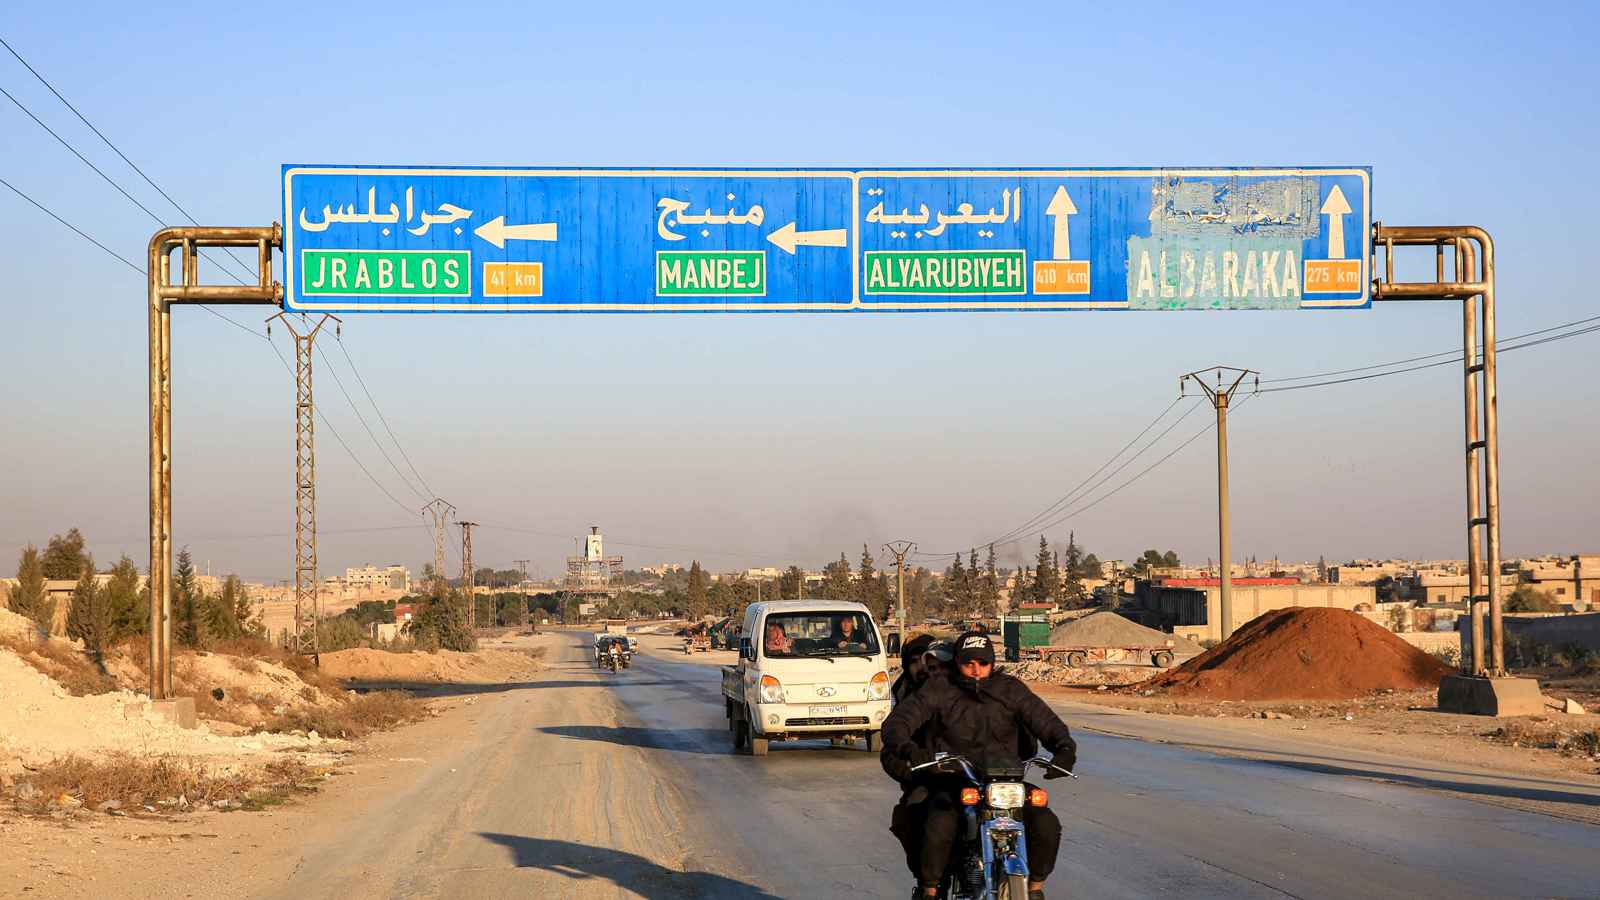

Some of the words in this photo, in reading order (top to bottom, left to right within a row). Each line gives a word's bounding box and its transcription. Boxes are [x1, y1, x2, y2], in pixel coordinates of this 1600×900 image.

[299, 185, 473, 236] جرابلس
[657, 192, 765, 241] منبج
[865, 187, 1021, 239] اليعربية
[311, 256, 460, 289] JRABLOS
[490, 270, 505, 286] 41
[515, 271, 536, 287] km
[661, 258, 761, 289] MANBEJ
[869, 257, 1021, 288] ALYARUBIYEH
[1036, 268, 1057, 284] 410
[1067, 269, 1088, 284] km
[1136, 249, 1300, 298] ALBARAKA
[1307, 267, 1329, 282] 275
[1336, 268, 1358, 283] km
